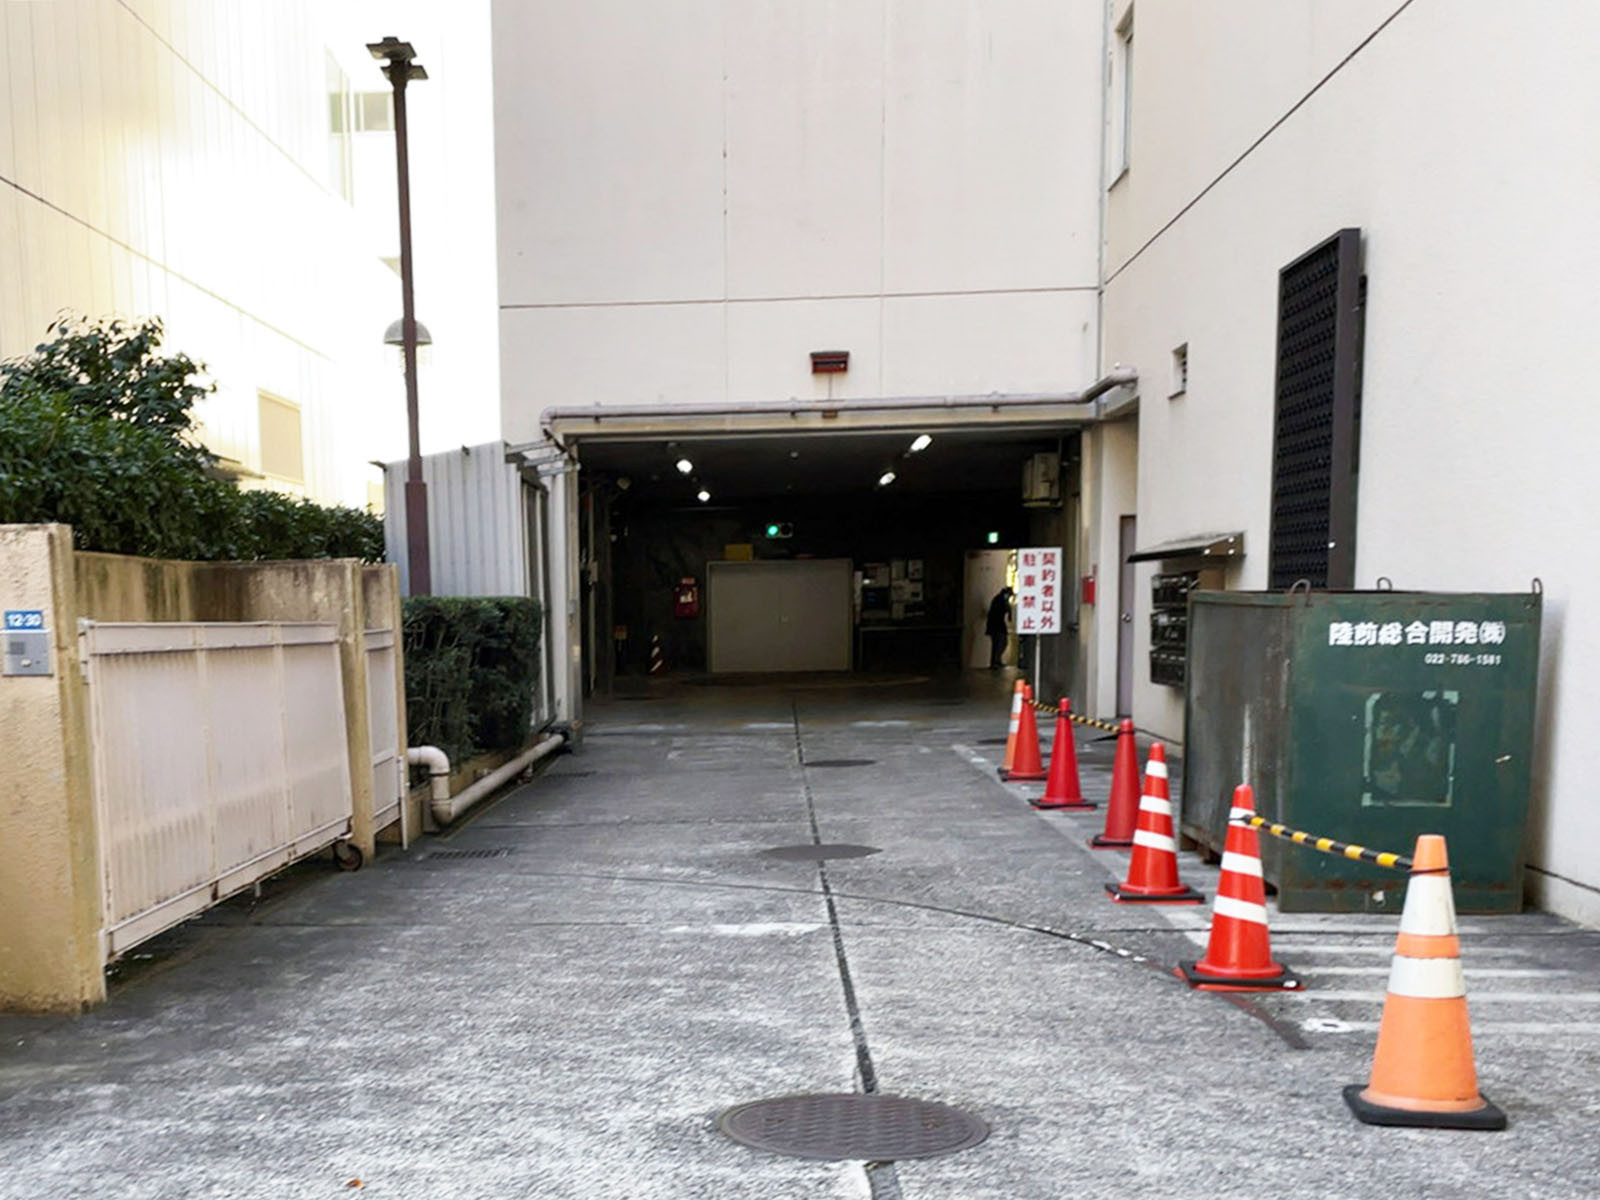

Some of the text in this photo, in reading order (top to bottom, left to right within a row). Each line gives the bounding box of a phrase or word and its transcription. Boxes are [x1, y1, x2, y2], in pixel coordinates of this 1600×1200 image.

[1023, 553, 1036, 629] 駐車禁止
[1041, 552, 1055, 628] 契約者以外
